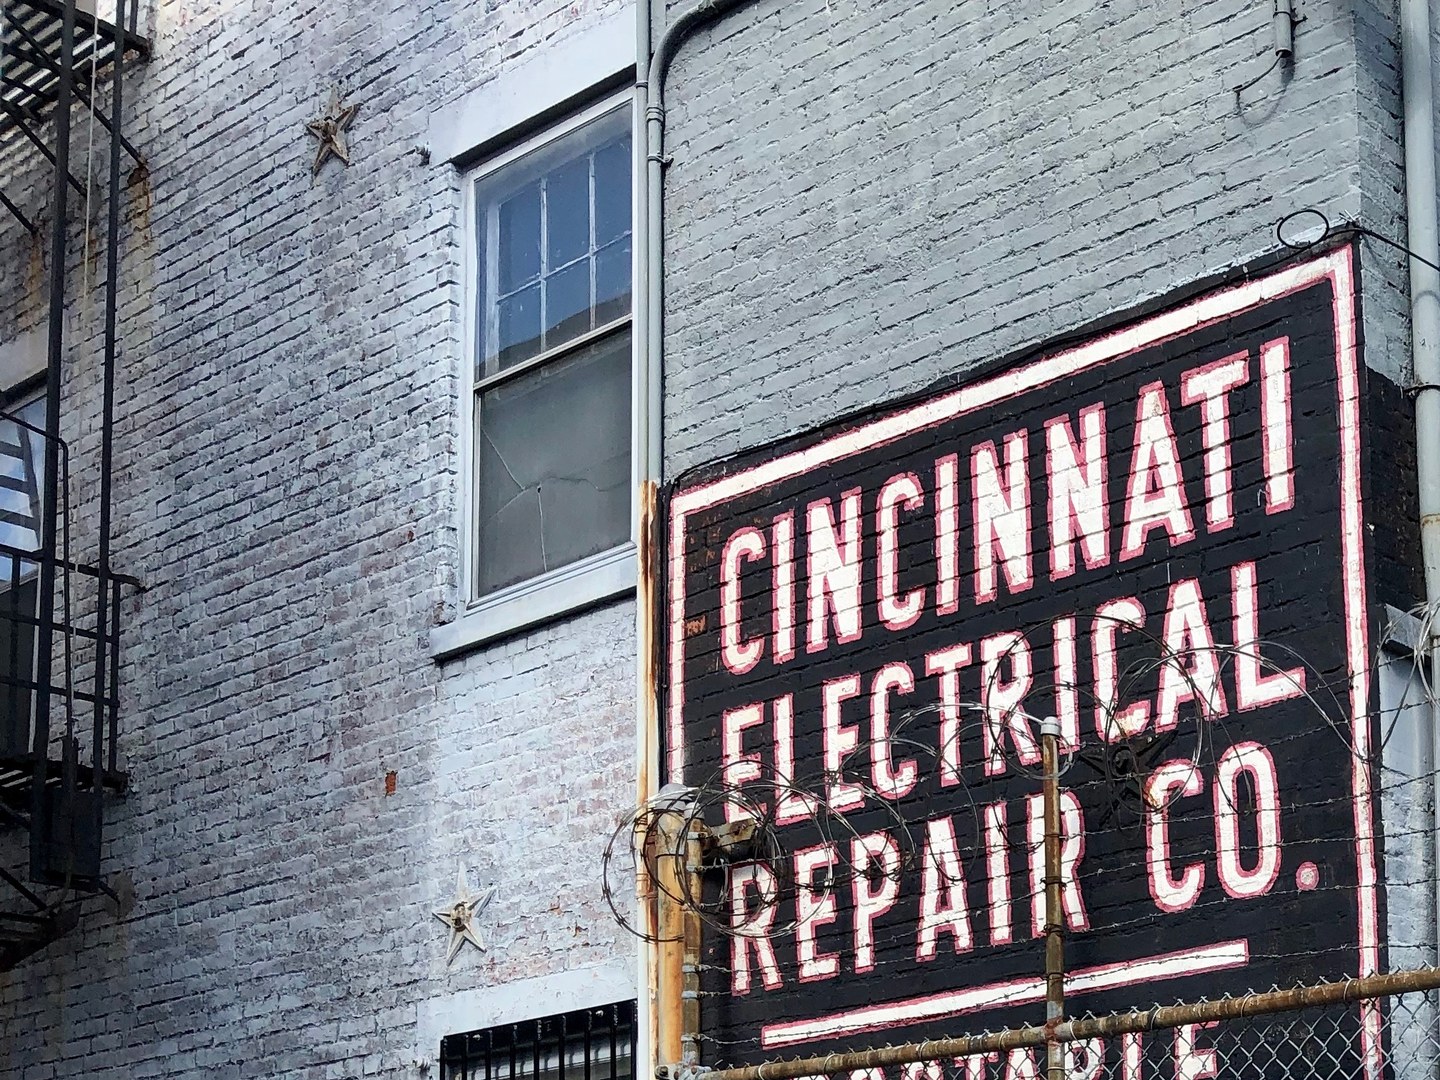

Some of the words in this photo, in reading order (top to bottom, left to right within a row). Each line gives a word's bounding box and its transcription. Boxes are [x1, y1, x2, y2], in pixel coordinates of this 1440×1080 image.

[720, 337, 1295, 676] CINCINNATI
[721, 560, 1308, 826] ELECTRICAL
[727, 789, 1091, 997] REPAIR
[1144, 740, 1319, 914] CO.
